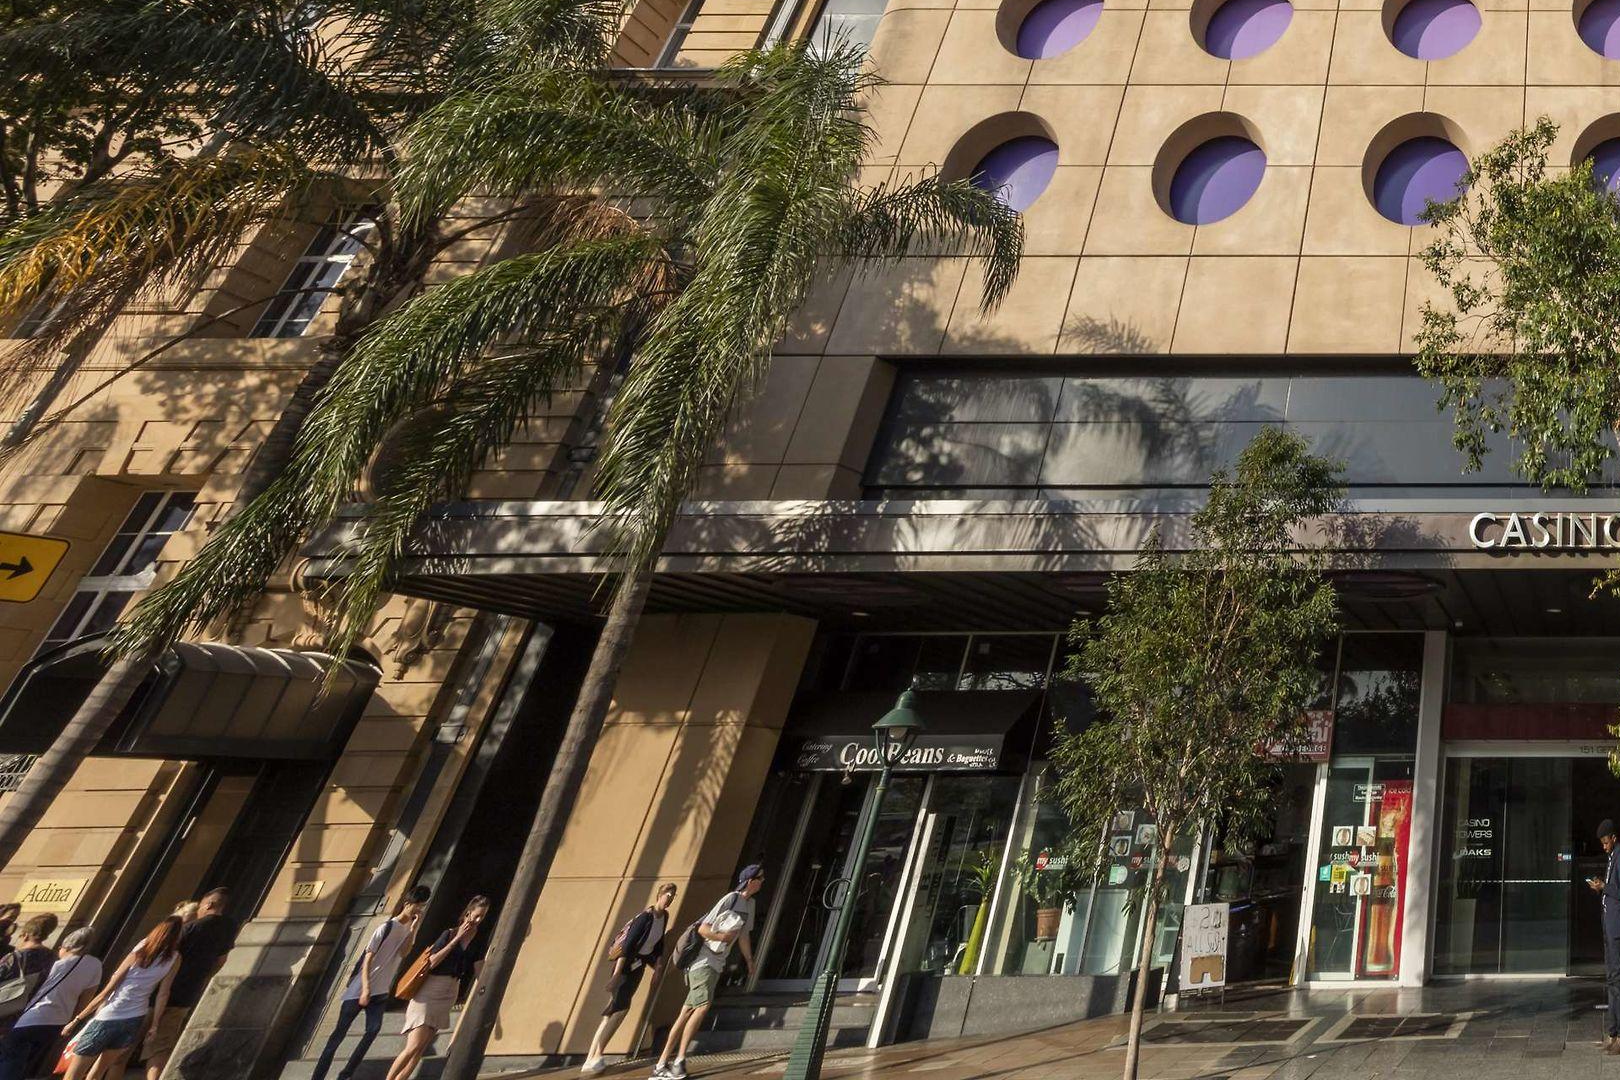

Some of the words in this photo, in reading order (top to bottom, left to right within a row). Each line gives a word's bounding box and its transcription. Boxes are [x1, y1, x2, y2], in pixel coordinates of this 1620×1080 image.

[1036, 855, 1049, 866] my
[1049, 855, 1069, 864] sushi
[20, 882, 73, 903] Adina
[294, 884, 316, 896] 171
